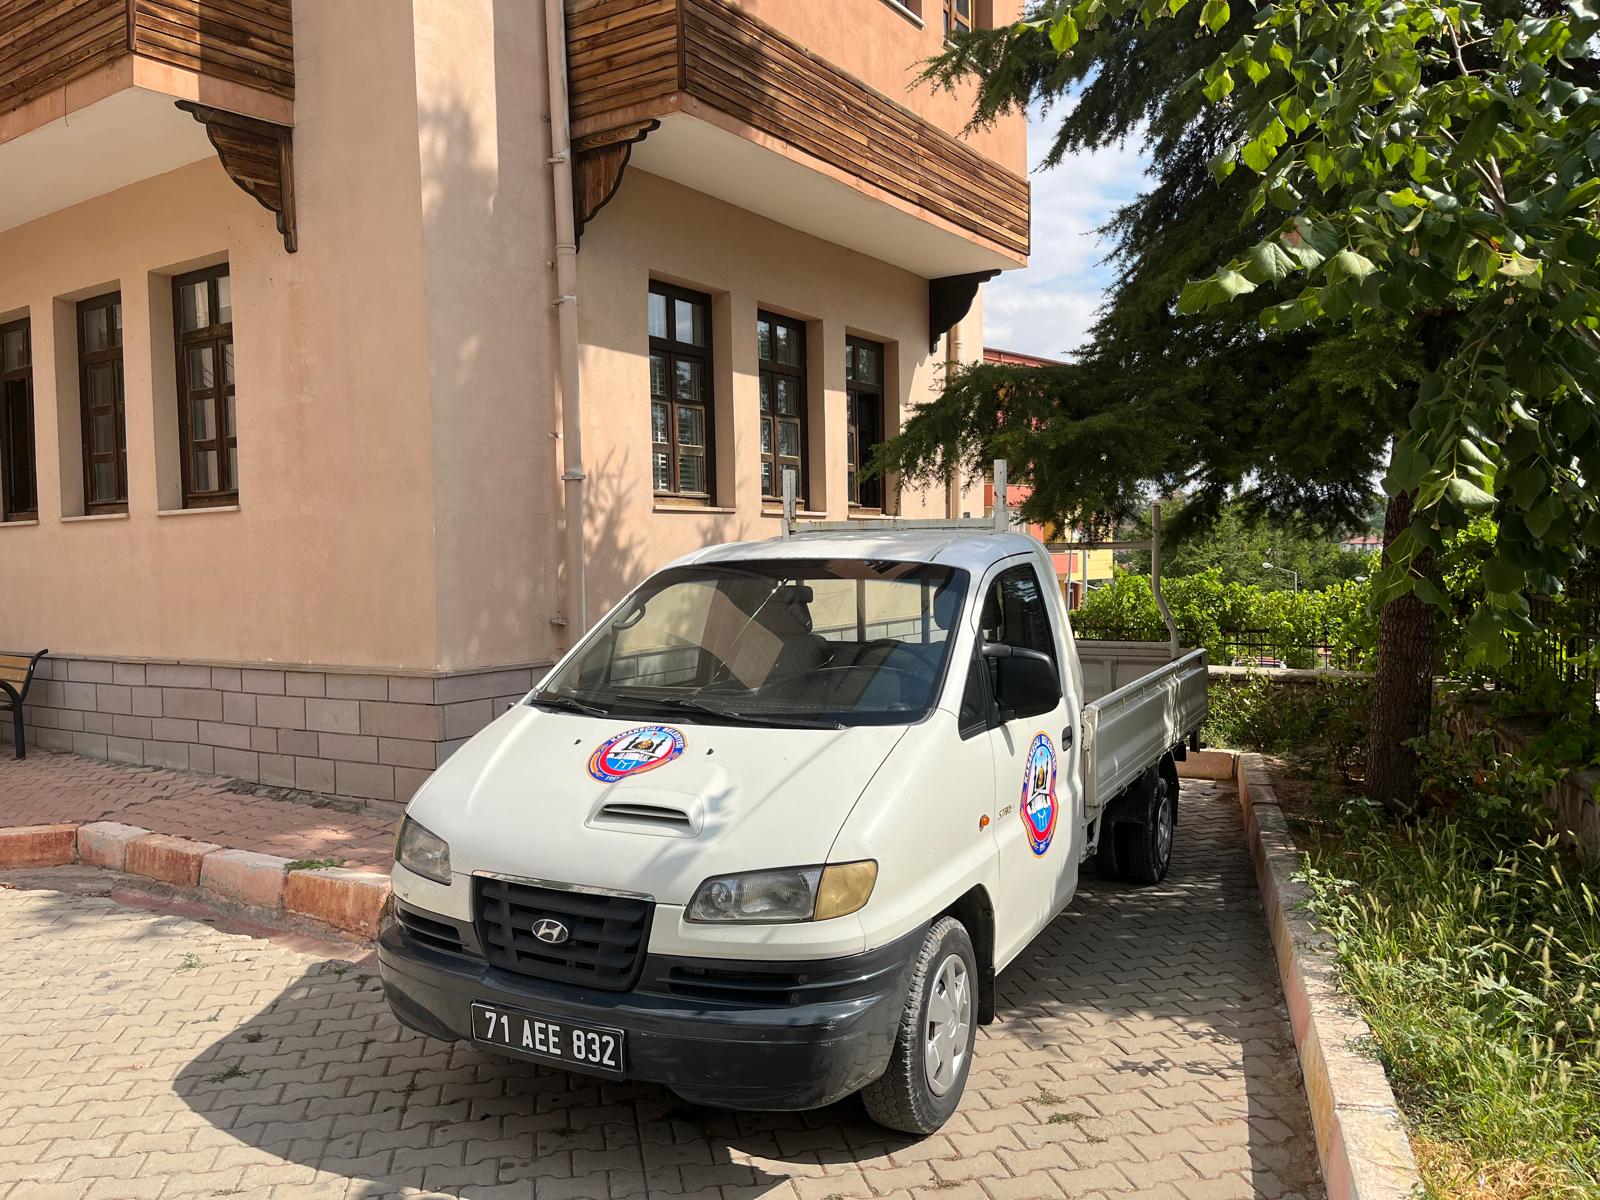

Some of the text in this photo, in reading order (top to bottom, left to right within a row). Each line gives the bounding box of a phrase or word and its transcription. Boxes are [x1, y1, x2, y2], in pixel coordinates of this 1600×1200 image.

[485, 1011, 616, 1066] 71 AEE 832
